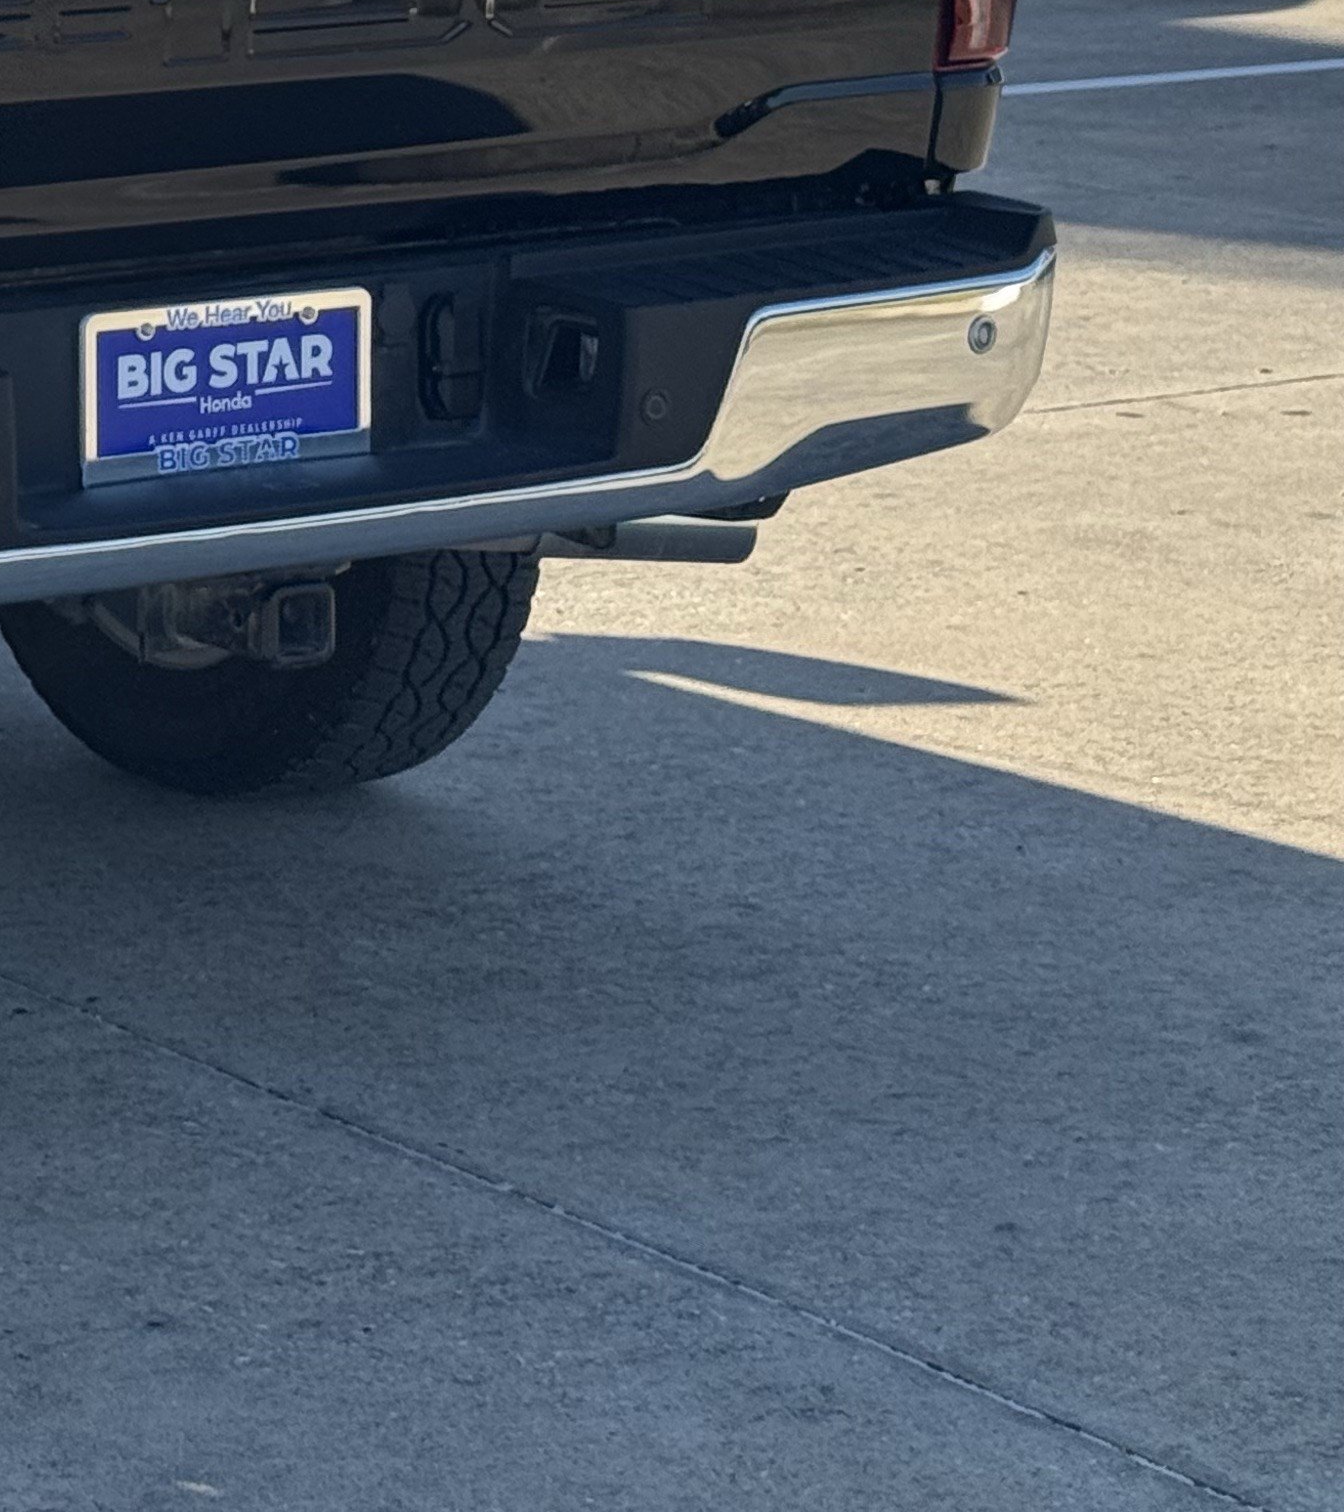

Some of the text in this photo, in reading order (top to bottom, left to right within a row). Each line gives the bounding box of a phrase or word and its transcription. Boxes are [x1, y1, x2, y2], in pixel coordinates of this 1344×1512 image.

[167, 300, 293, 328] We Hear You
[117, 333, 333, 400] BIG STAR
[199, 390, 253, 414] Honda
[161, 431, 185, 443] KEN
[188, 425, 227, 440] GARFF
[231, 417, 304, 435] DEALERSHIP
[159, 436, 298, 472] BIG STAR
